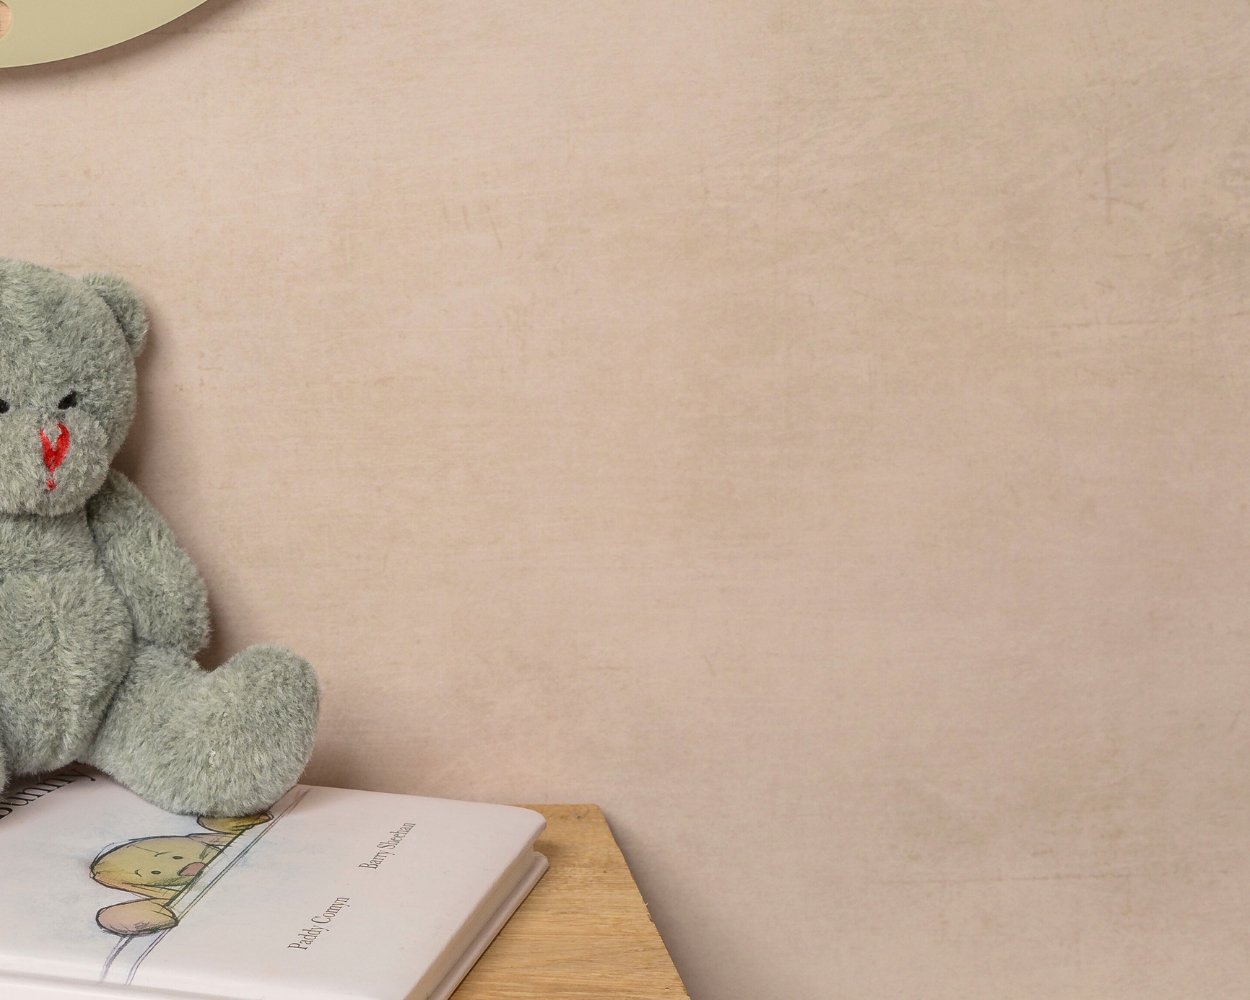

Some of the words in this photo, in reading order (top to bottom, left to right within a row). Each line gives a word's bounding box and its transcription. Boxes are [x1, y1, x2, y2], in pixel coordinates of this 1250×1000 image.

[376, 822, 416, 850] Sheehan
[358, 849, 395, 870] Barry
[287, 924, 330, 951] Paddy
[310, 897, 351, 924] Comyn
